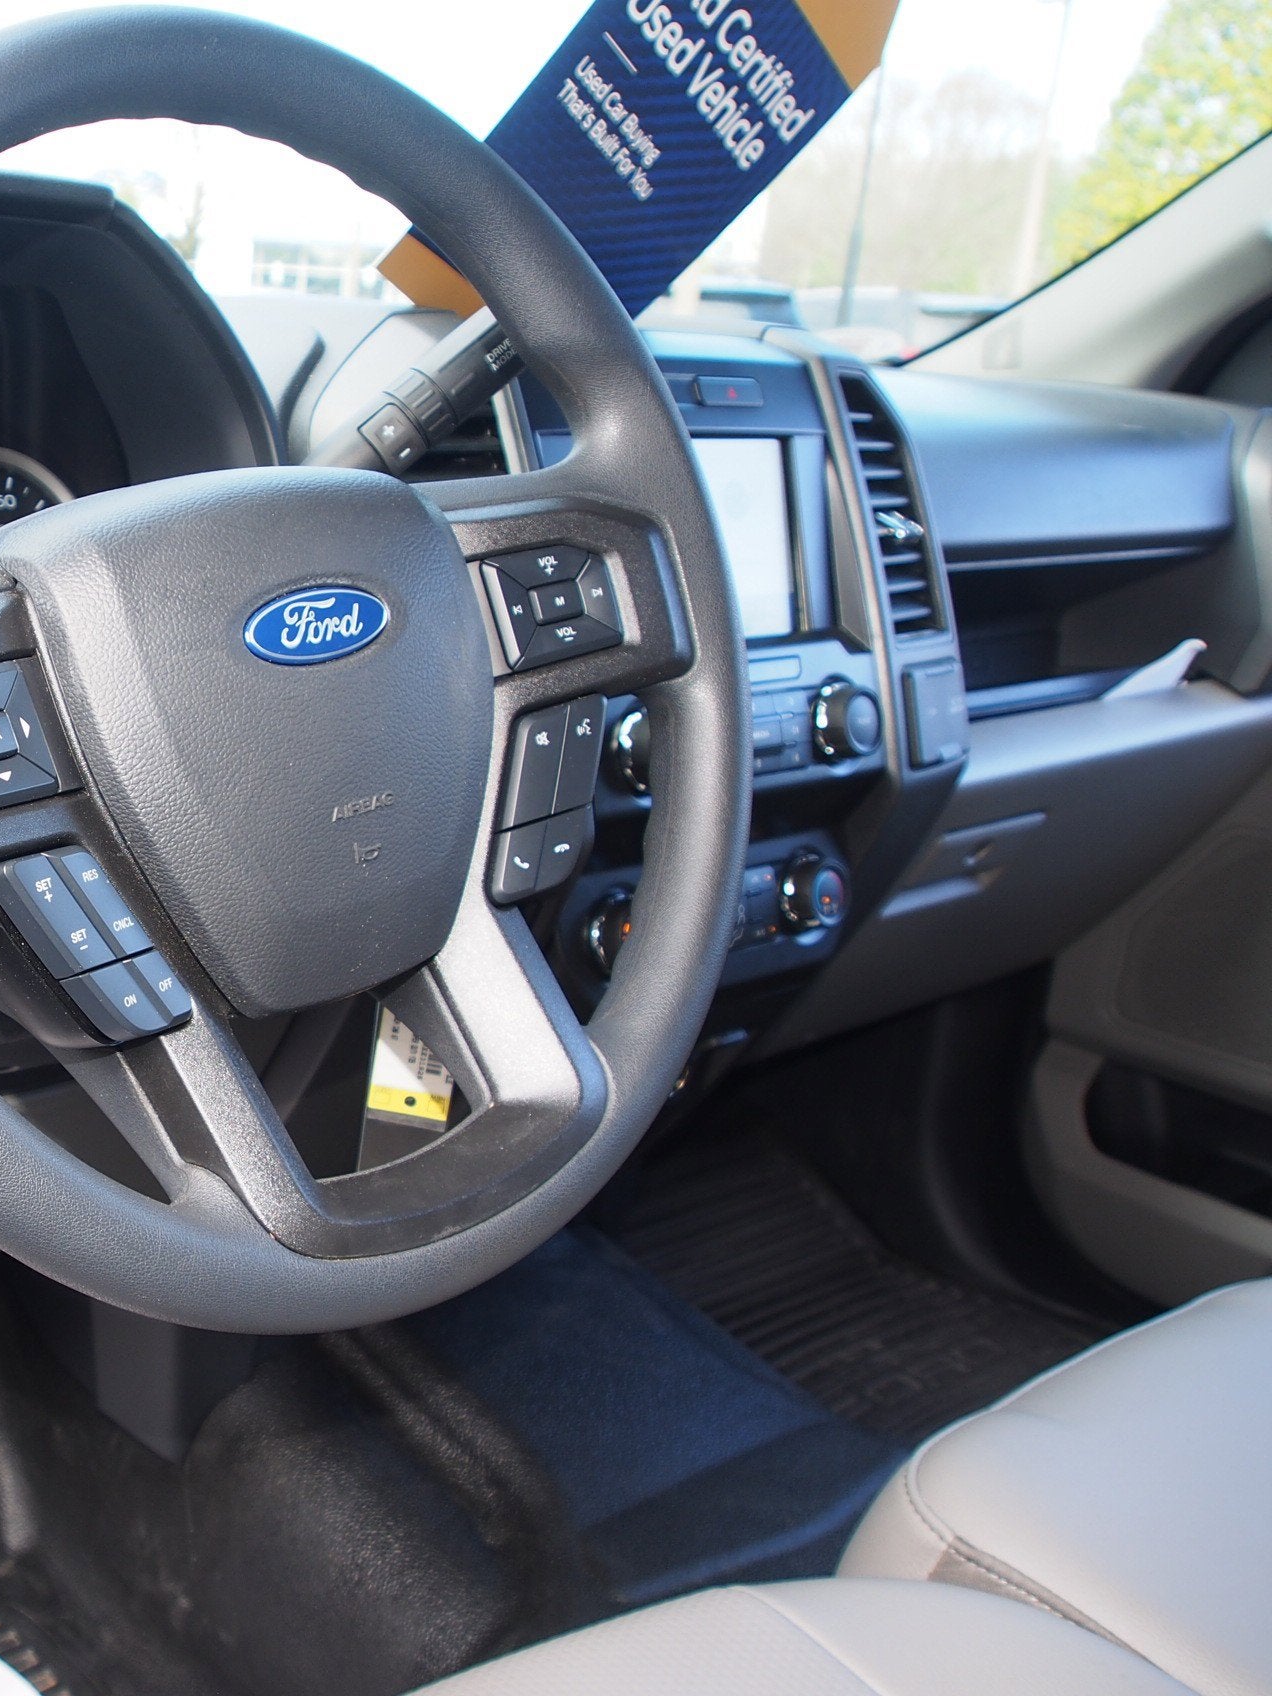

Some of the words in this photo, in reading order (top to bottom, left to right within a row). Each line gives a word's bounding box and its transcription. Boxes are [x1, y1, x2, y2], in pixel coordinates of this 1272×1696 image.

[715, 9, 817, 144] Certified
[626, 0, 706, 77] Used
[686, 51, 766, 171] Vehicle
[574, 55, 614, 103] Used
[602, 91, 629, 125] Car
[619, 113, 662, 169] Buying
[588, 118, 621, 158] Built
[611, 147, 636, 178] For
[629, 166, 654, 201] You
[486, 338, 512, 363] DRIVE
[537, 556, 559, 567] VOL
[554, 596, 566, 607] M
[280, 597, 363, 648] Ford
[555, 626, 577, 638] VOL
[331, 790, 395, 822] AIRBAG
[82, 868, 99, 883] RES
[35, 877, 52, 892] SET
[113, 916, 135, 932] CNCL
[70, 928, 87, 944] SET
[159, 977, 173, 992] OFF
[124, 993, 138, 1008] ON
